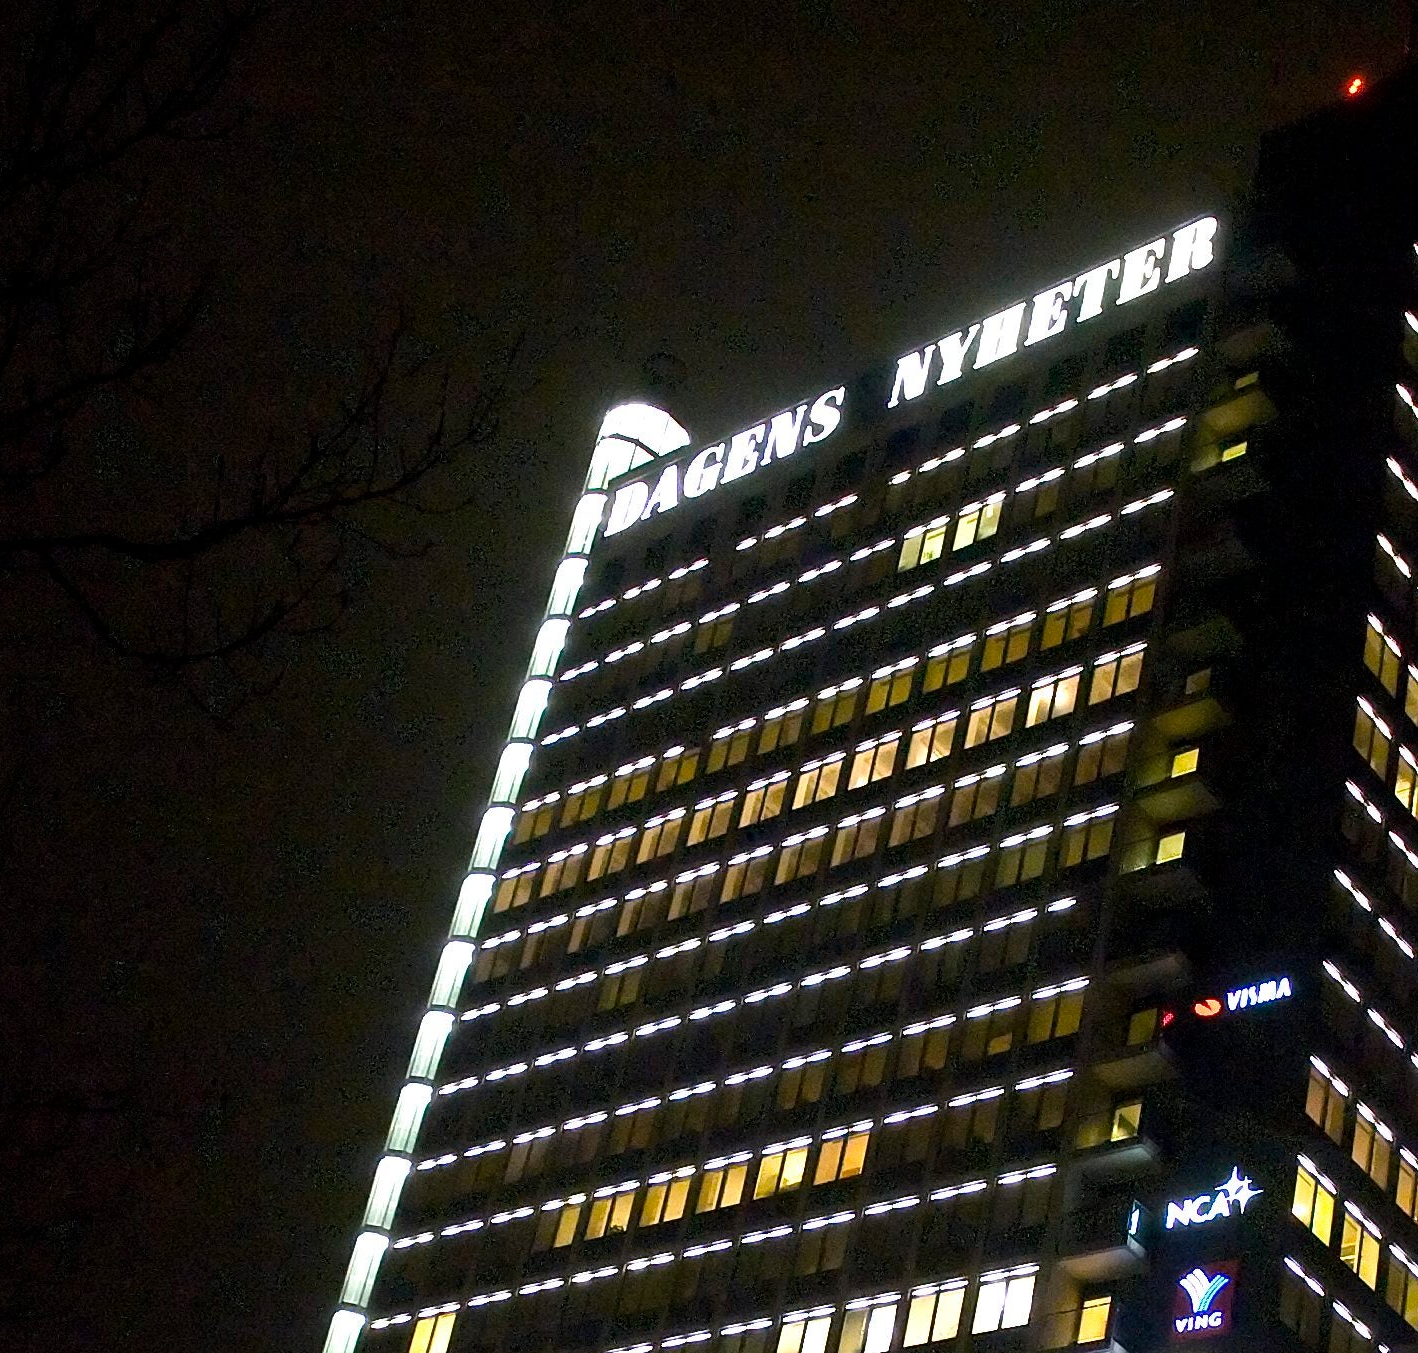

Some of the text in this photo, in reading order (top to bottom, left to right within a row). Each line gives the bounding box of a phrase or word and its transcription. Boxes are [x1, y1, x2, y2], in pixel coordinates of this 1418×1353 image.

[604, 215, 1219, 537] DAGENS NYHETER
[1227, 977, 1292, 1011] VISMA
[1165, 1190, 1231, 1230] NCA
[1175, 1311, 1223, 1333] VING
